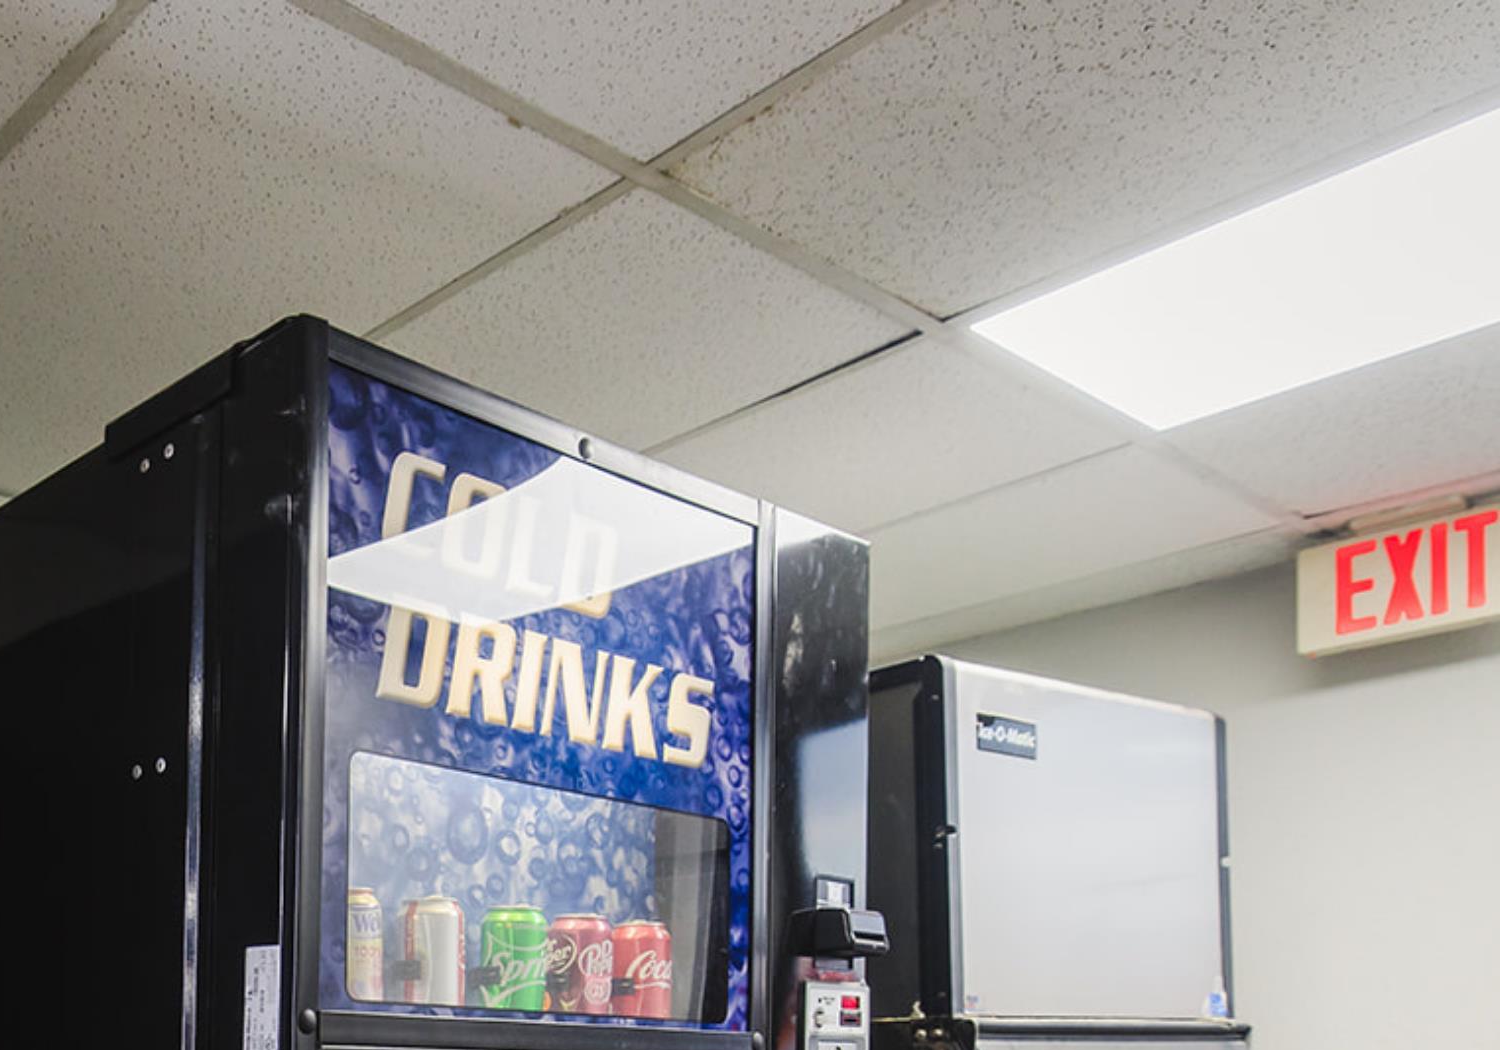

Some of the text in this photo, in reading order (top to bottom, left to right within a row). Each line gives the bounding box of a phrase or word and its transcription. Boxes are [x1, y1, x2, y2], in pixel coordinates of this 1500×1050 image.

[381, 451, 618, 618] COLD
[1335, 509, 1498, 636] EXIT
[376, 594, 714, 768] DRINKS
